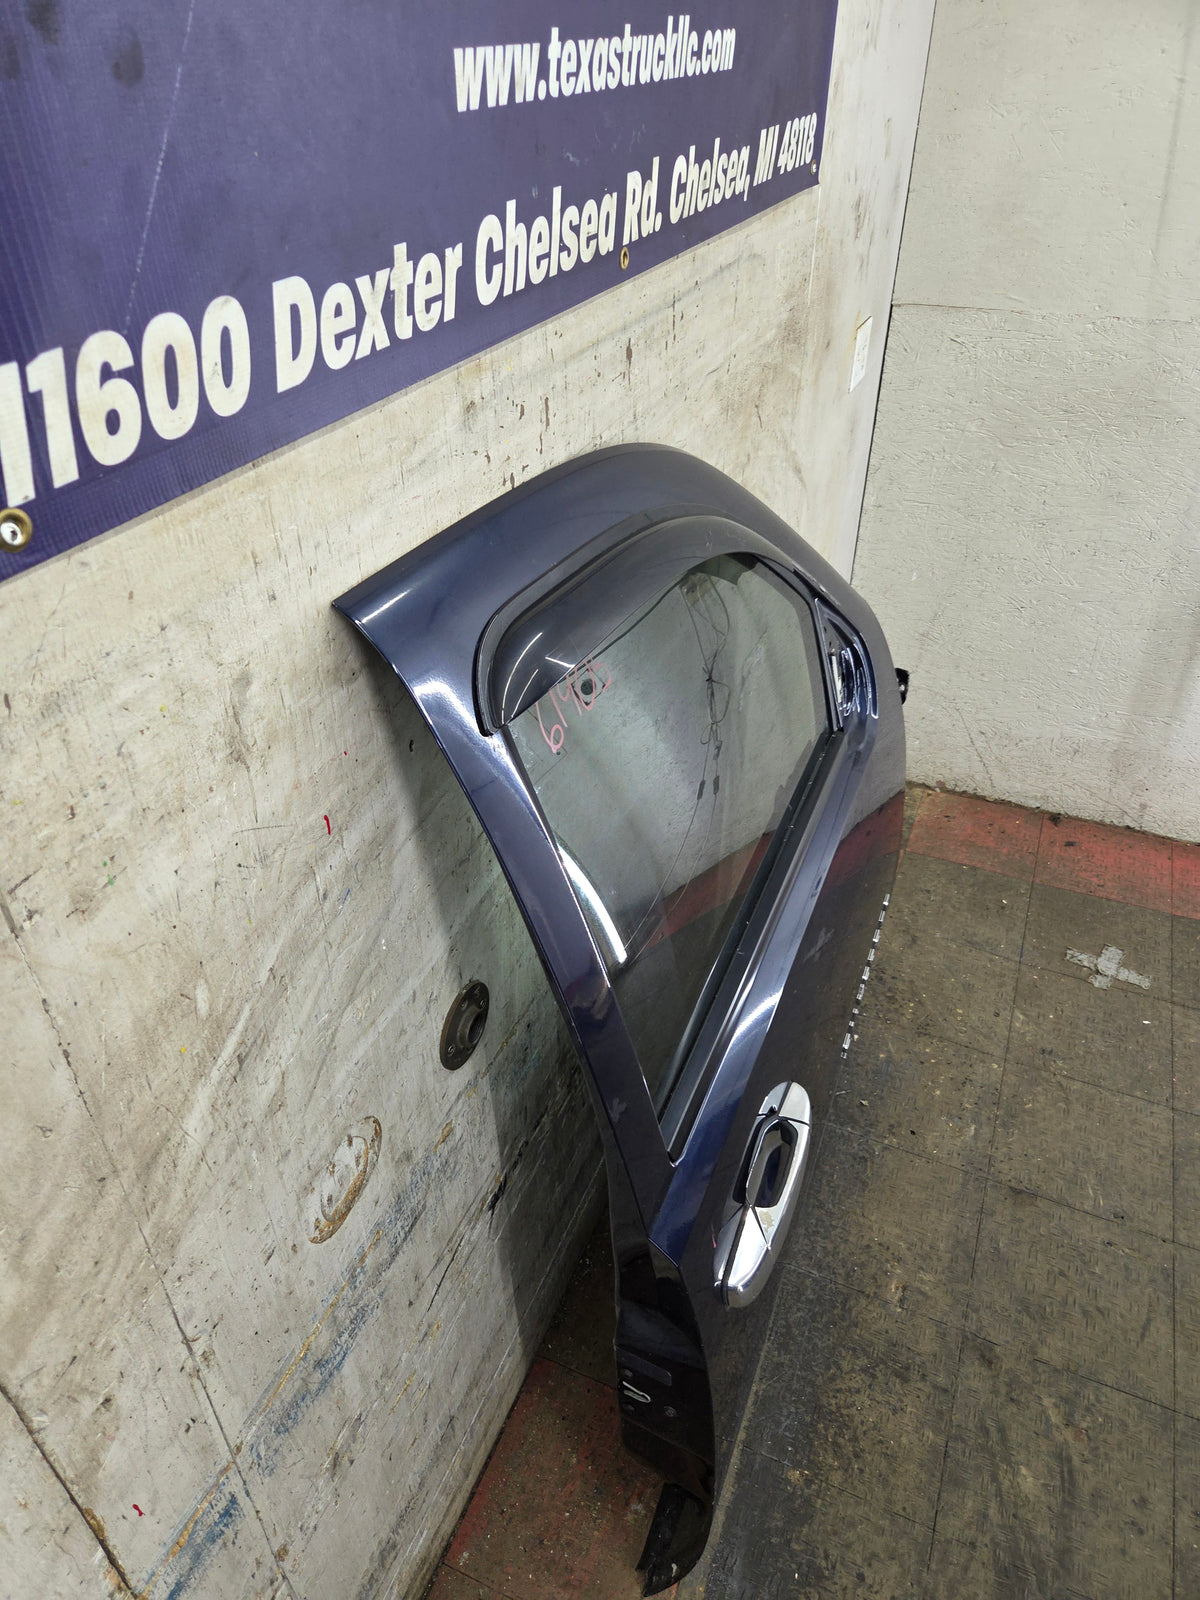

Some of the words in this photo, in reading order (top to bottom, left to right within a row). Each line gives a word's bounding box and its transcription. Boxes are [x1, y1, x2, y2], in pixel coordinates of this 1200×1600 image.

[453, 14, 736, 113] www.texastruckllc.com
[0, 294, 252, 508] 11600
[272, 241, 463, 393] Dexter
[475, 185, 617, 306] Chelsea
[623, 156, 662, 246] Rd.
[669, 138, 750, 224] Chelsea,
[753, 125, 779, 187] MI
[778, 112, 817, 175] 48118
